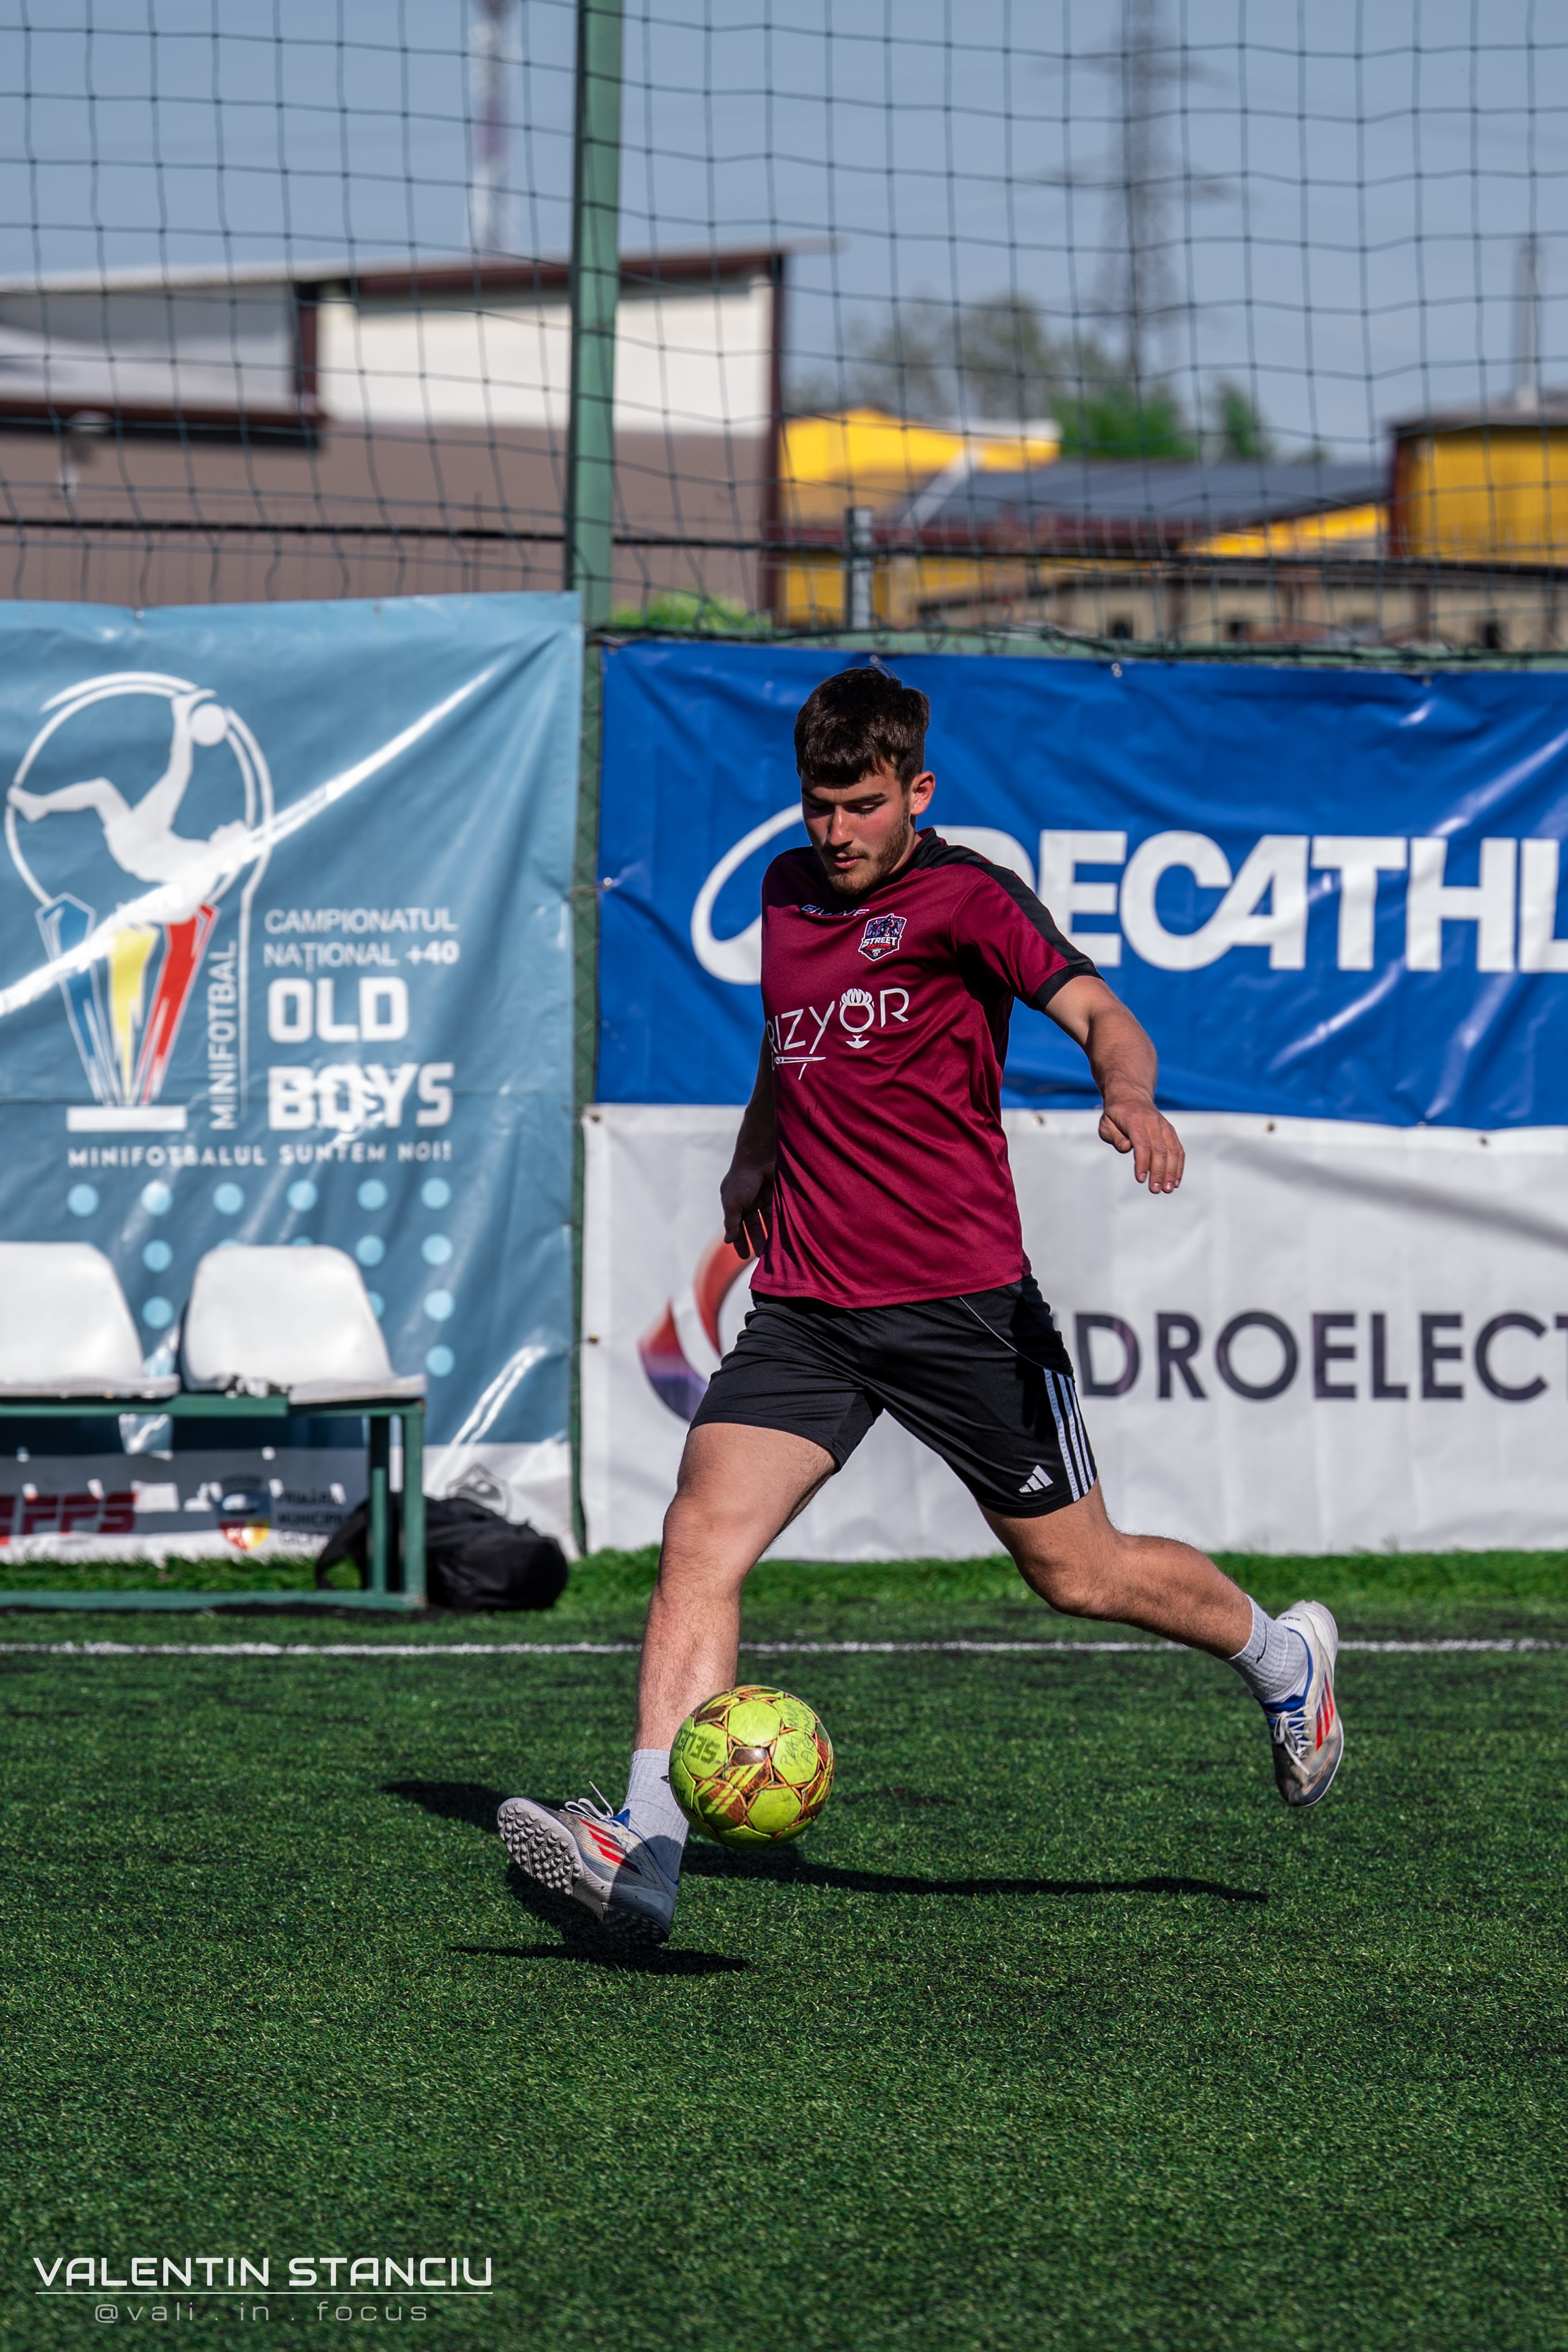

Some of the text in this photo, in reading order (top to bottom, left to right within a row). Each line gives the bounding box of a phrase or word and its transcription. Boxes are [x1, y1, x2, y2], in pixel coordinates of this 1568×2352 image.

[264, 908, 459, 935] CAMPIONATUL
[861, 937, 897, 948] STREET
[405, 940, 460, 966] +40
[268, 976, 409, 1043] OLD
[208, 940, 238, 1130] MINIFOTBAL
[268, 1062, 454, 1130] BOYS
[68, 1140, 452, 1168] MINIFOTBALUL SUNTEM NOI!
[1051, 1310, 1568, 1401] DROELEC
